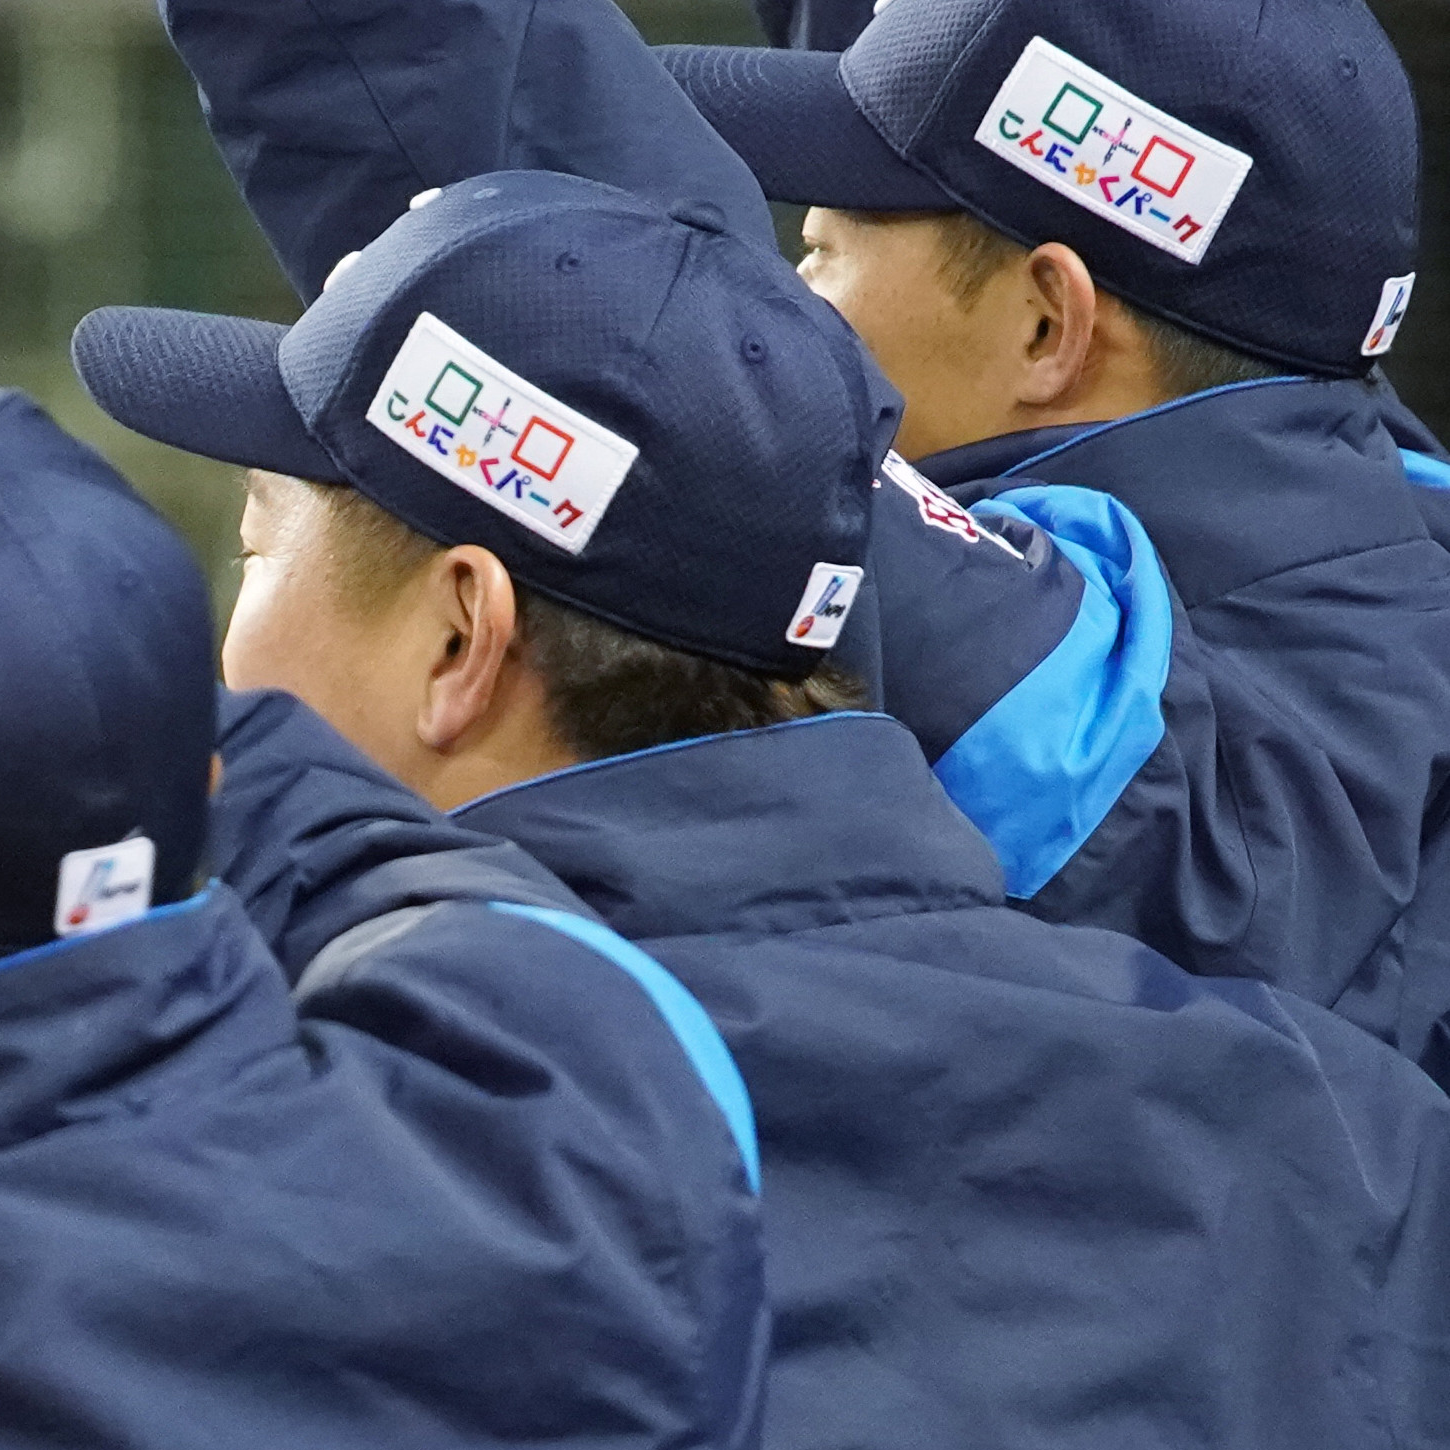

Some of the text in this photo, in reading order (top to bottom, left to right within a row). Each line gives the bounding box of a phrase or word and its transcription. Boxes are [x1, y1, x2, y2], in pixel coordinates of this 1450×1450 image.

[998, 108, 1204, 244] こんにゃくパーク
[386, 389, 585, 530] こんにゃくパーク
